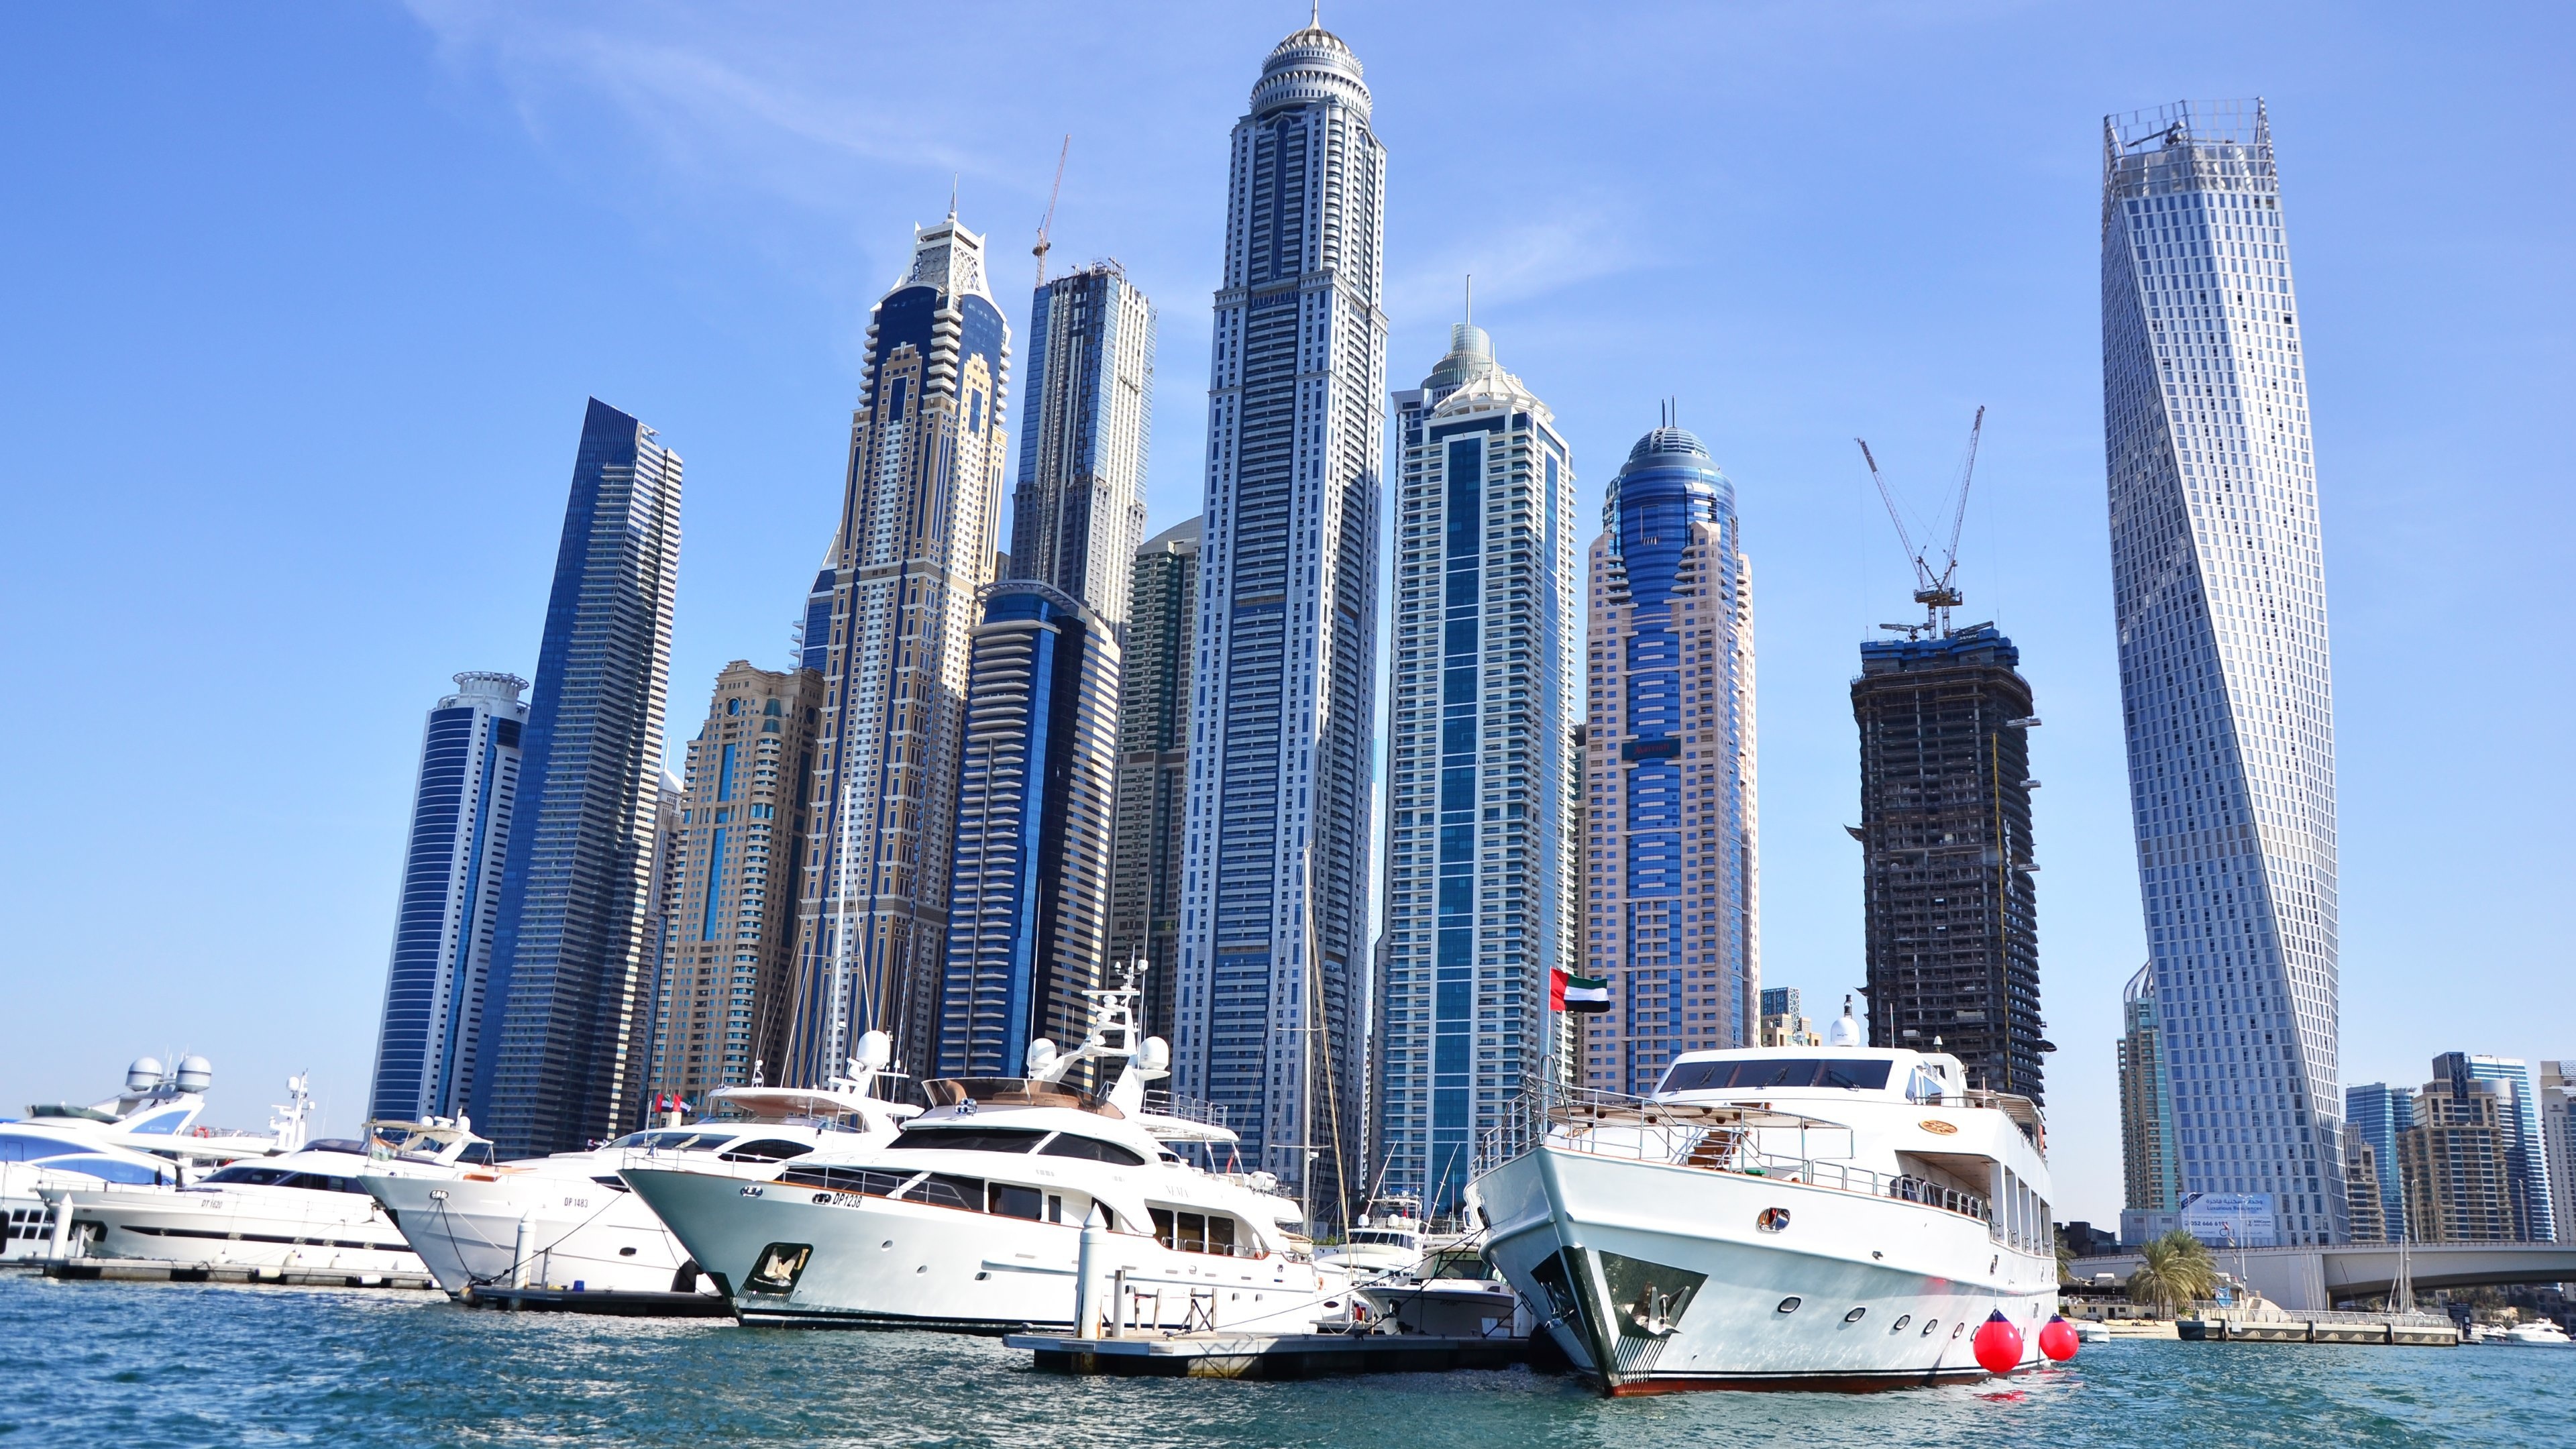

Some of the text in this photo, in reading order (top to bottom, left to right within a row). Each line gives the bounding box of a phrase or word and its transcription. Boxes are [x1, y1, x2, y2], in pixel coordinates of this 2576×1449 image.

[2004, 819, 2014, 897] DAMAC
[564, 1197, 588, 1208] DP 1483
[833, 1192, 863, 1208] DP1238
